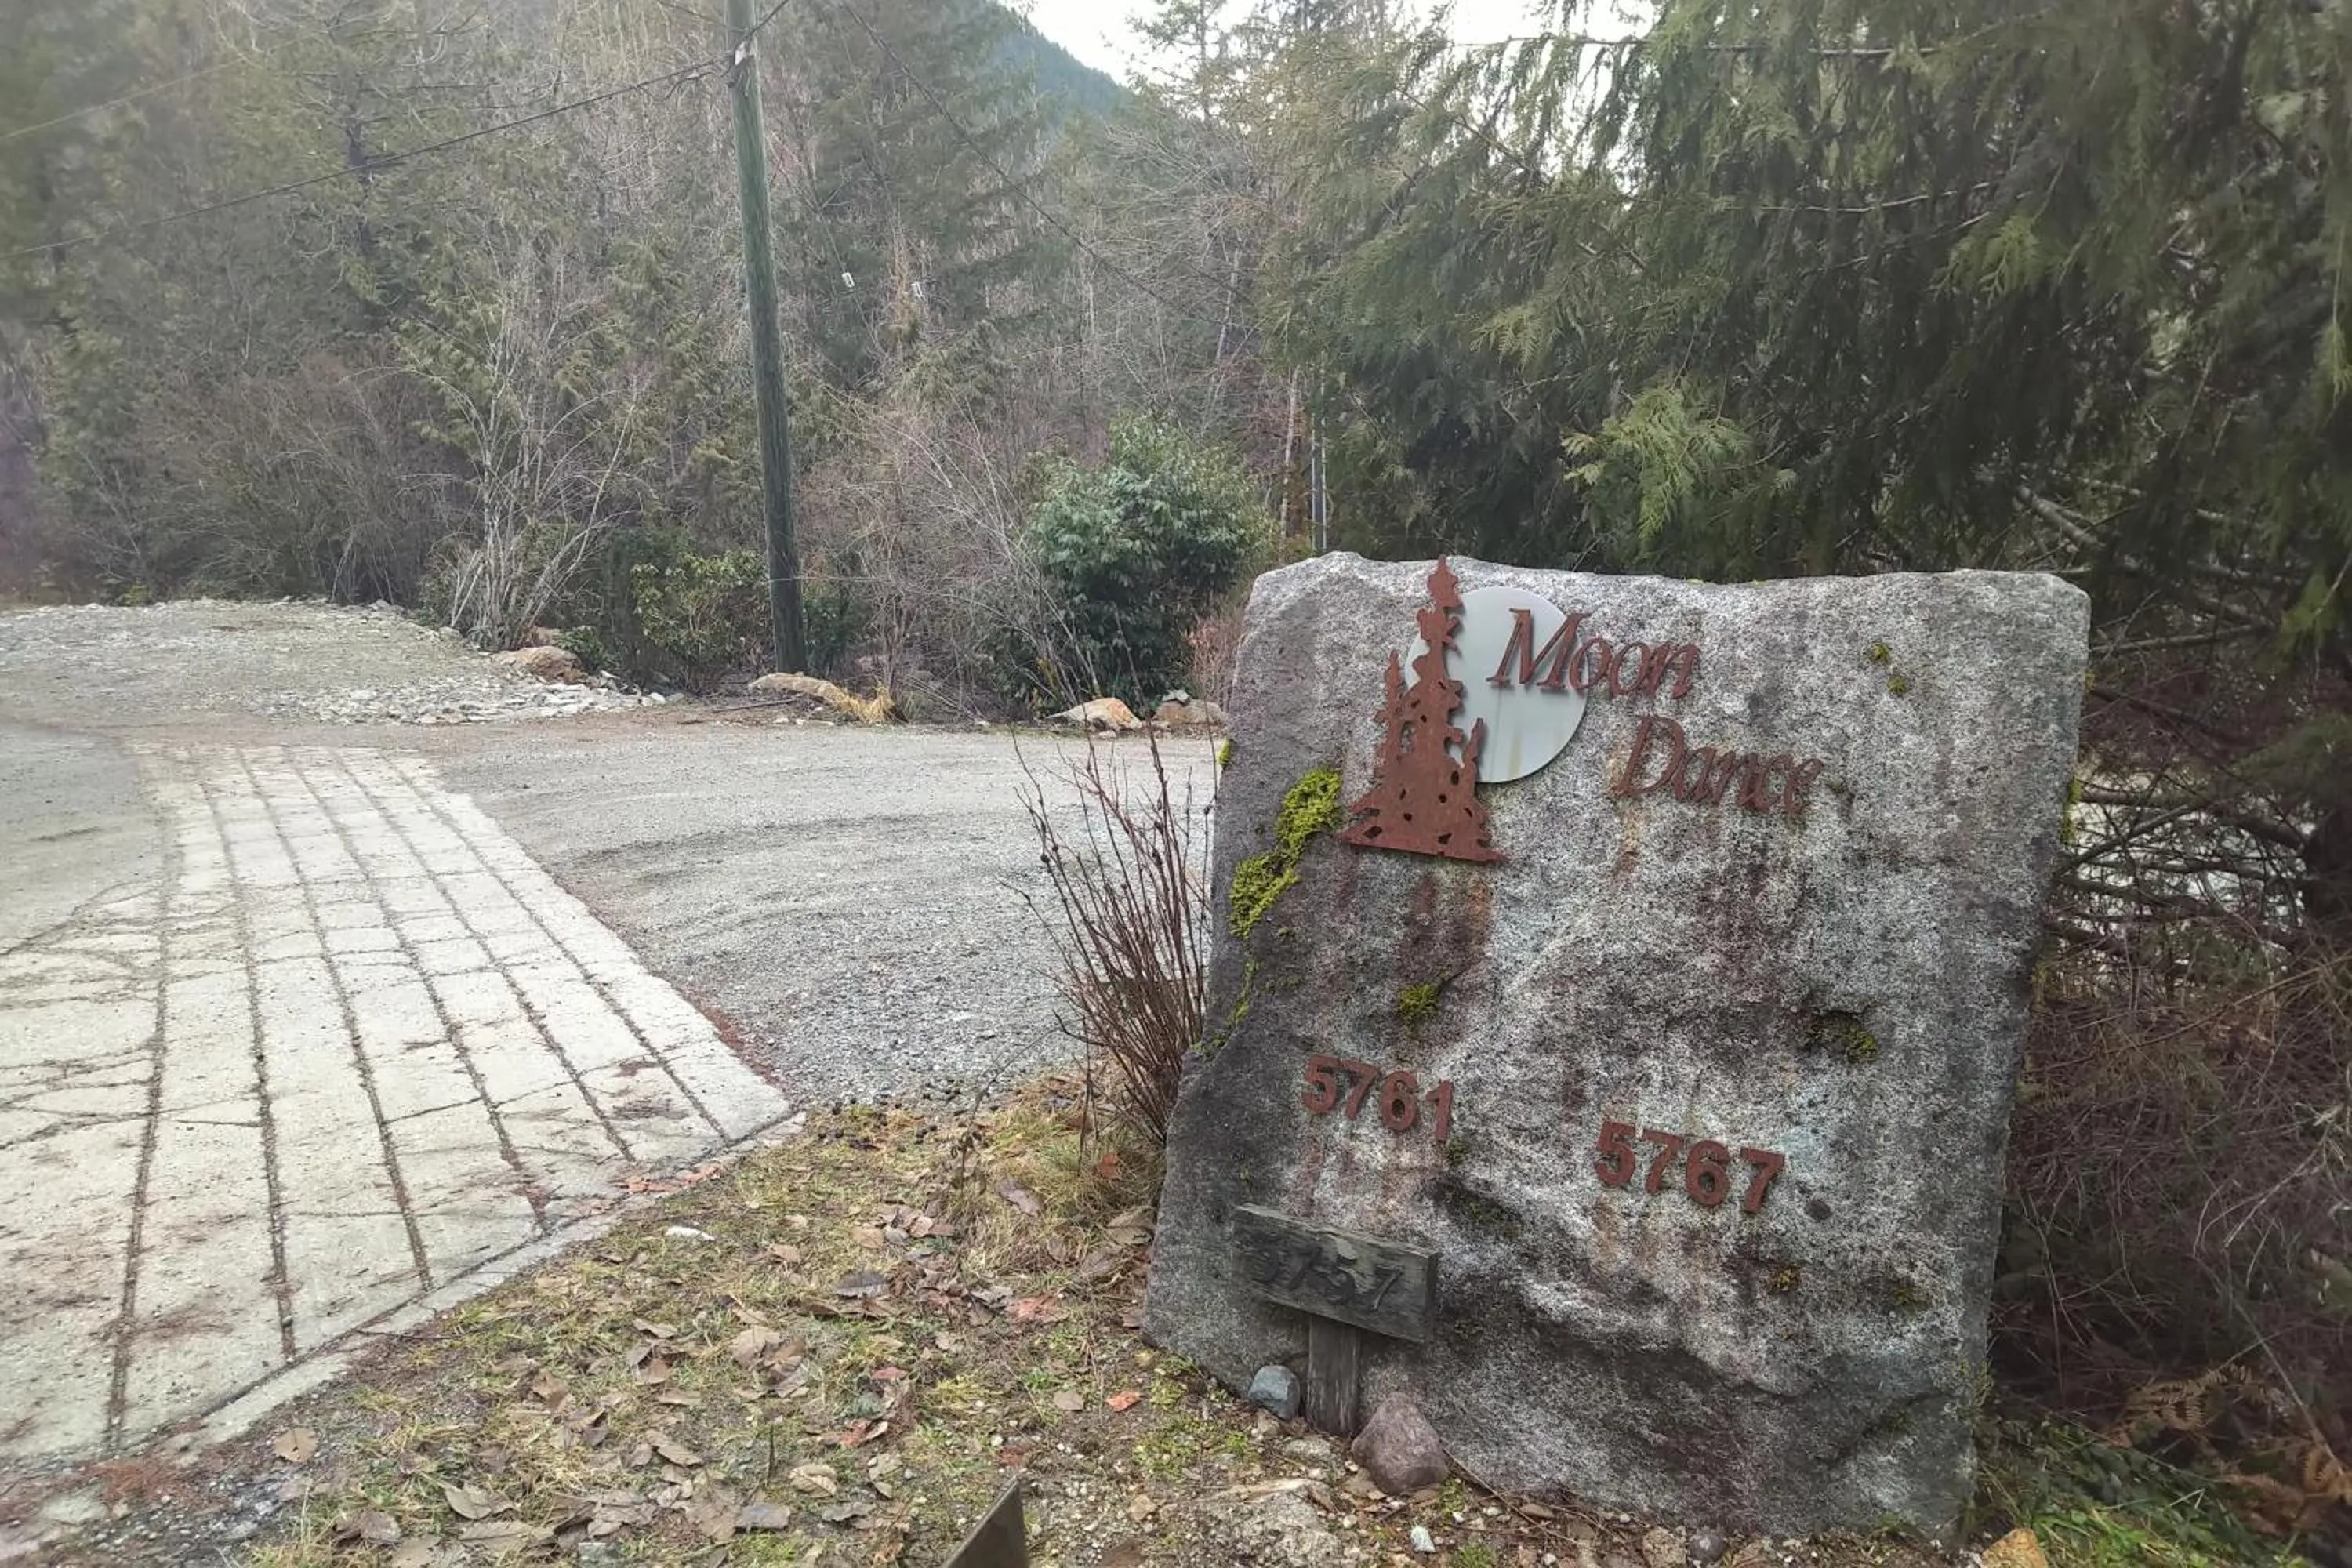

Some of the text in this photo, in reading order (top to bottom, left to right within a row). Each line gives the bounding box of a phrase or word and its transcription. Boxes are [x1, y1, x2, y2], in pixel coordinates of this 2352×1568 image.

[1486, 608, 1700, 700] Moon
[1610, 714, 1824, 815] Dance
[1301, 1054, 1455, 1142] 5761
[1594, 1121, 1784, 1214] 5767
